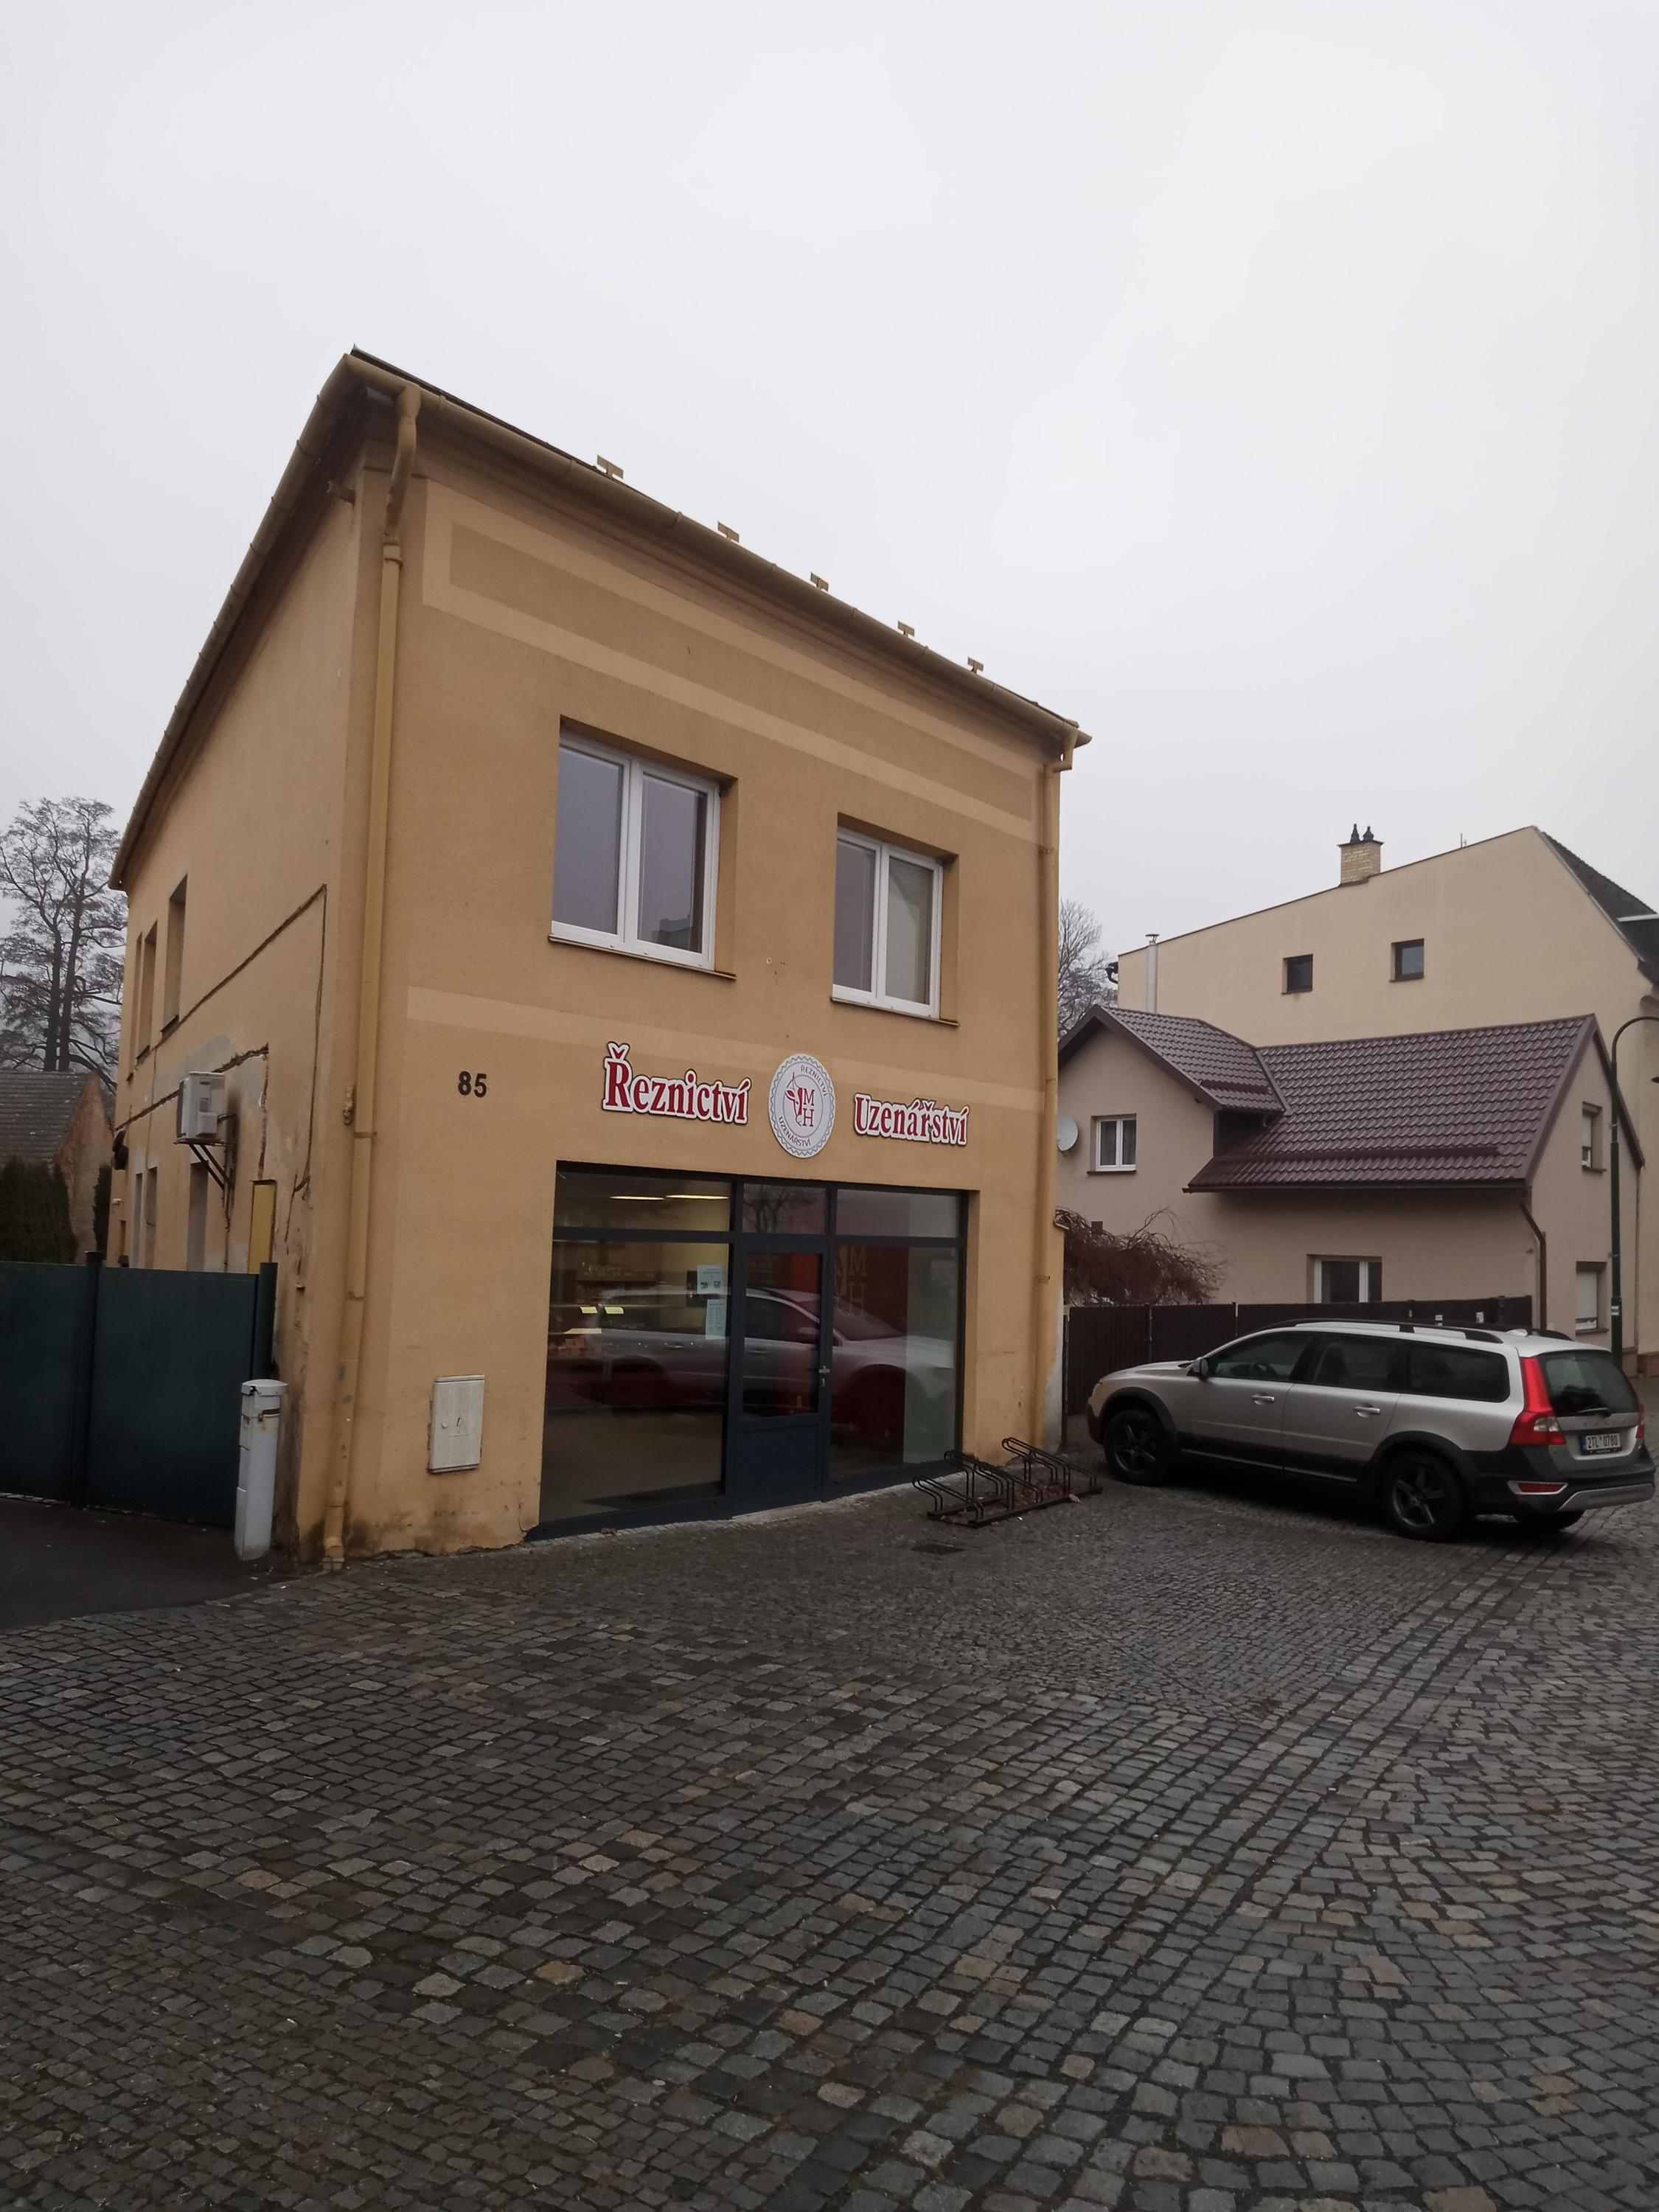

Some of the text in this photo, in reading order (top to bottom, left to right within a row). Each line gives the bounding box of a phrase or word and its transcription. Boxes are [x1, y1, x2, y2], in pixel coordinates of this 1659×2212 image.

[458, 1071, 487, 1099] 85
[604, 1044, 751, 1122] Řeznictví
[803, 1088, 815, 1106] M
[802, 1108, 814, 1127] H
[855, 1096, 968, 1144] Uzenářství
